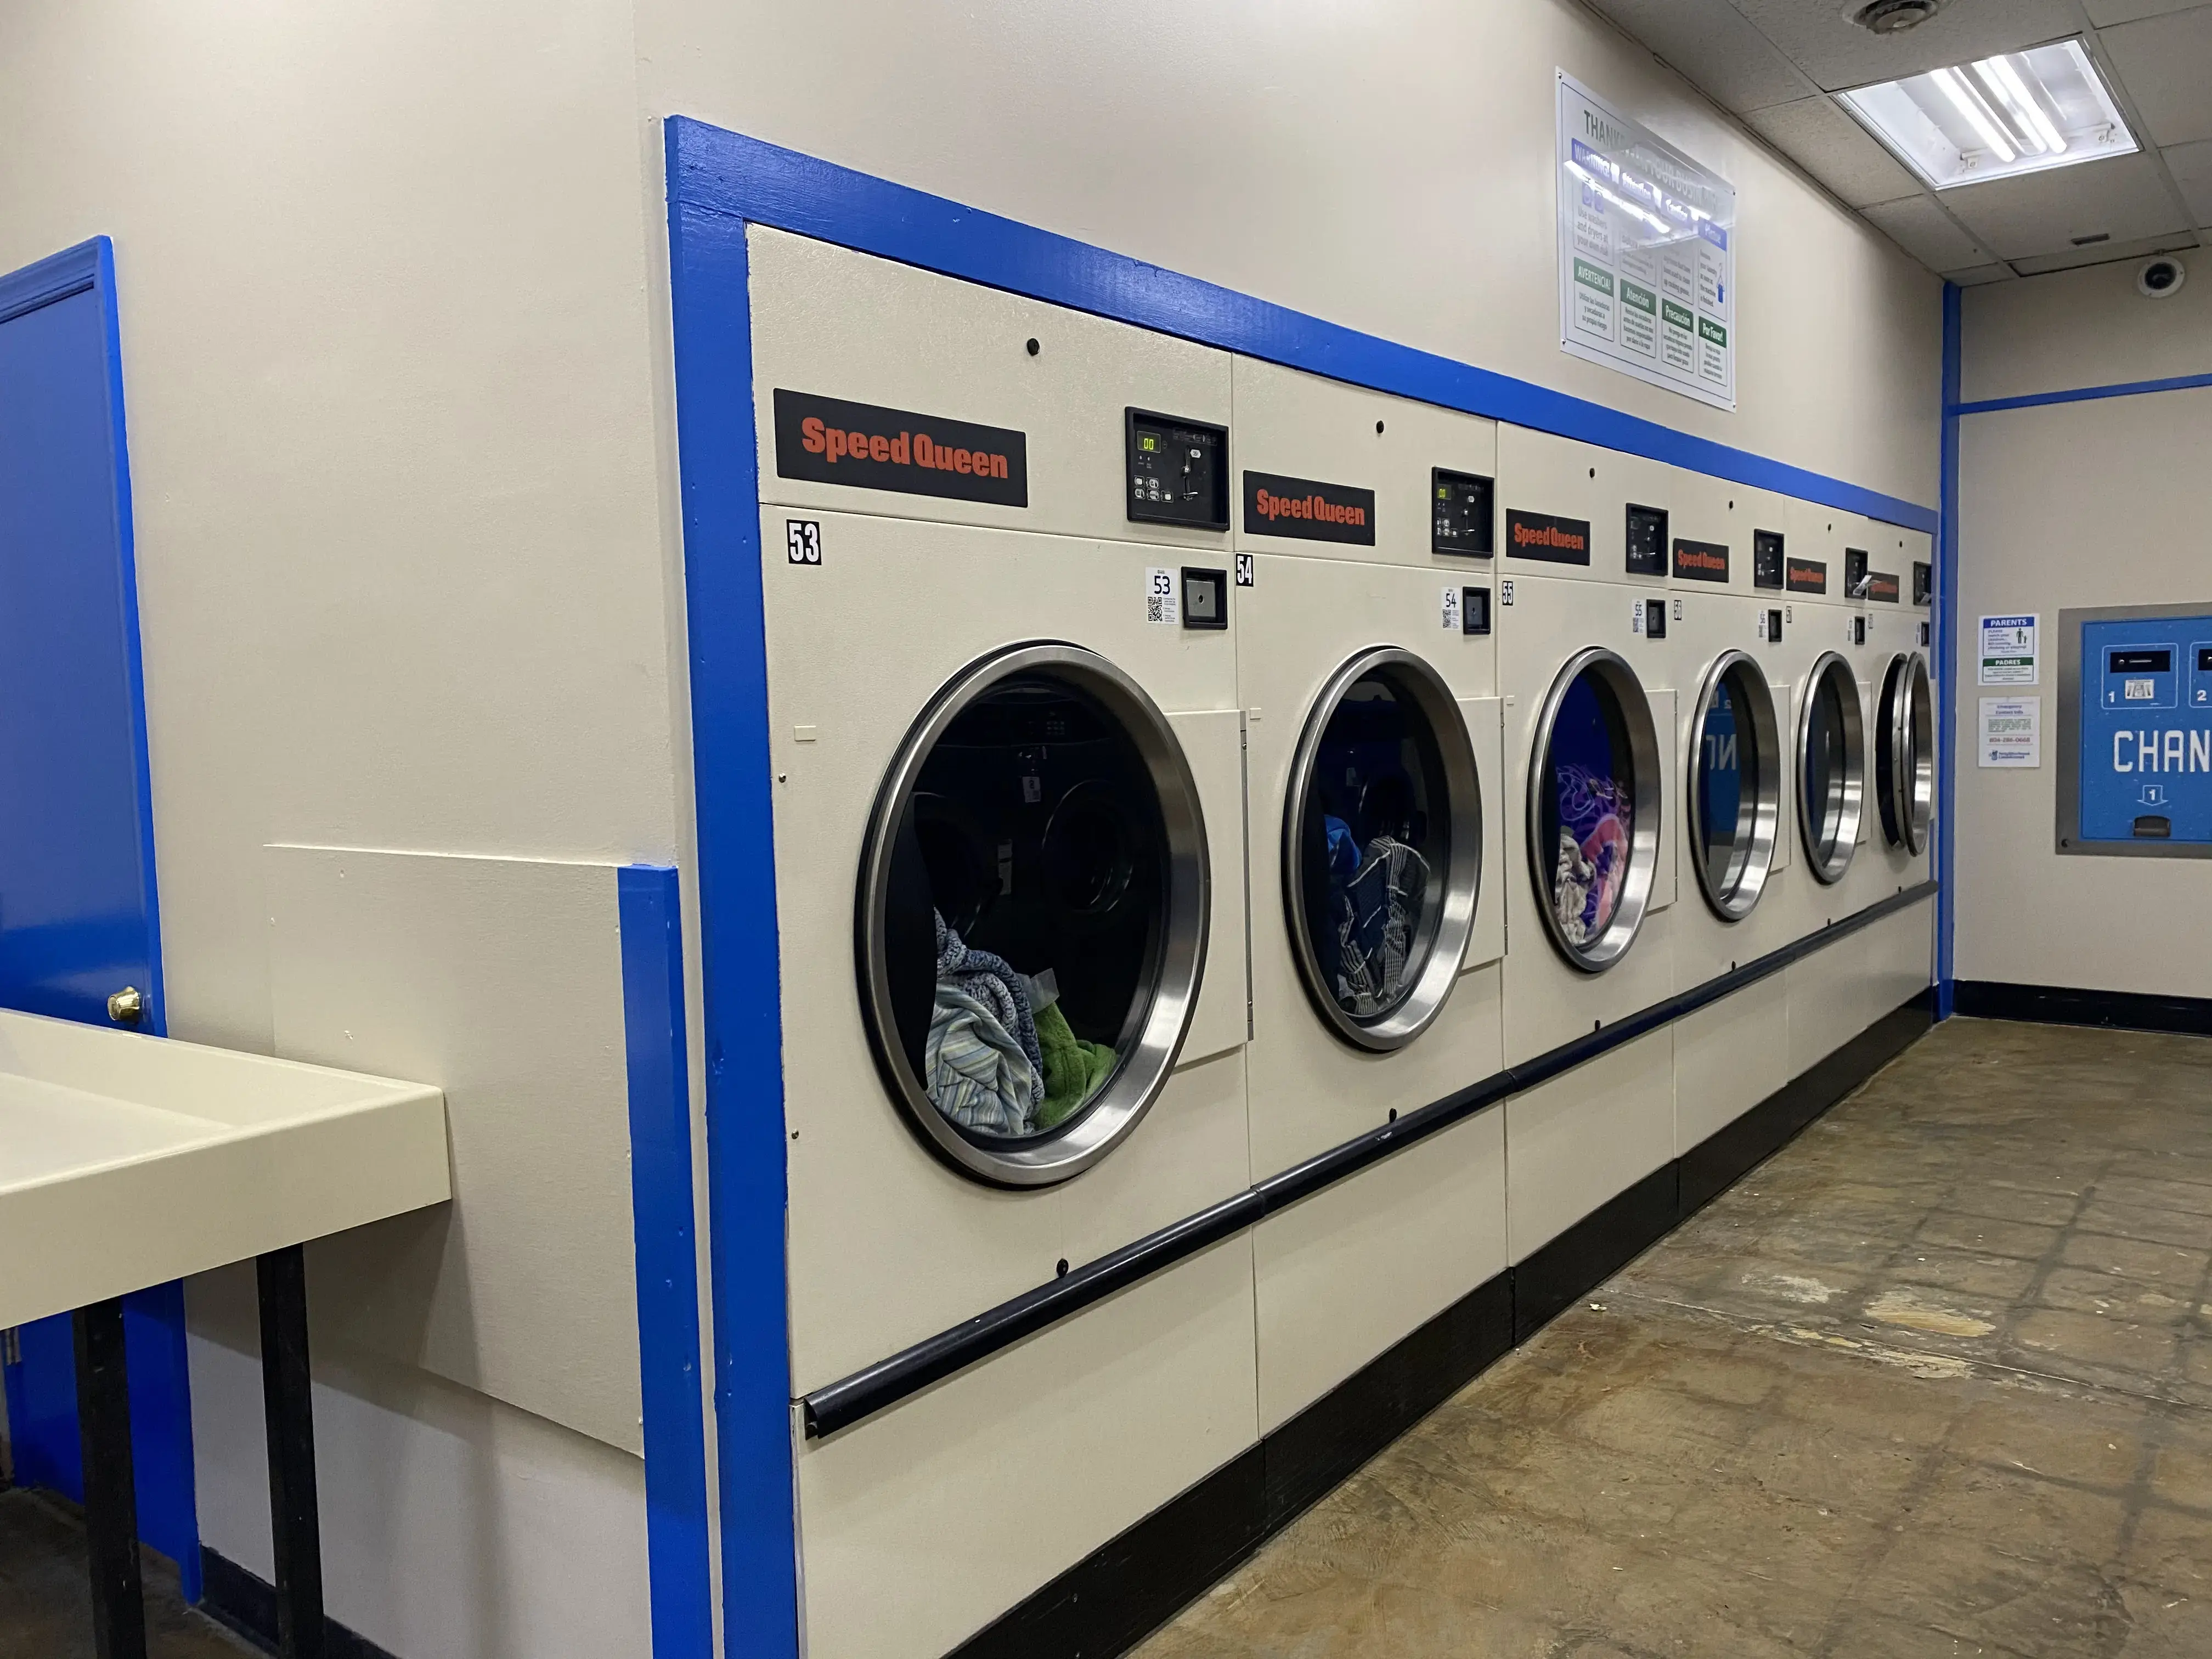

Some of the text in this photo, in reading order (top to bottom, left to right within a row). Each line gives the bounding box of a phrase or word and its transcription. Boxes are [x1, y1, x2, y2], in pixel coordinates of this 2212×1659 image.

[1574, 143, 1610, 178] WARNING!
[1578, 205, 1587, 219] Use
[1577, 218, 1587, 233] and
[1588, 223, 1602, 242] dryers
[1578, 266, 1611, 290] AVERTENCIA!
[1627, 287, 1649, 308] Atención
[1666, 305, 1691, 327] Precaución
[802, 417, 1008, 479] Speed Queen
[1144, 438, 1154, 450] 00
[1256, 488, 1365, 526] Speed Queen
[788, 522, 819, 562] 53
[1514, 522, 1584, 550] Speed Queen
[1237, 555, 1252, 584] 54
[1678, 549, 1725, 570] Speed Queen
[1154, 575, 1171, 595] 53
[1503, 582, 1513, 605] 55
[1446, 592, 1457, 608] 54
[1635, 603, 1643, 617] 55
[1990, 618, 2027, 627] PARENTS
[2108, 691, 2115, 703] 1
[2196, 689, 2207, 702] 2
[2113, 729, 2211, 773] CHAN
[2149, 789, 2156, 801] 1
